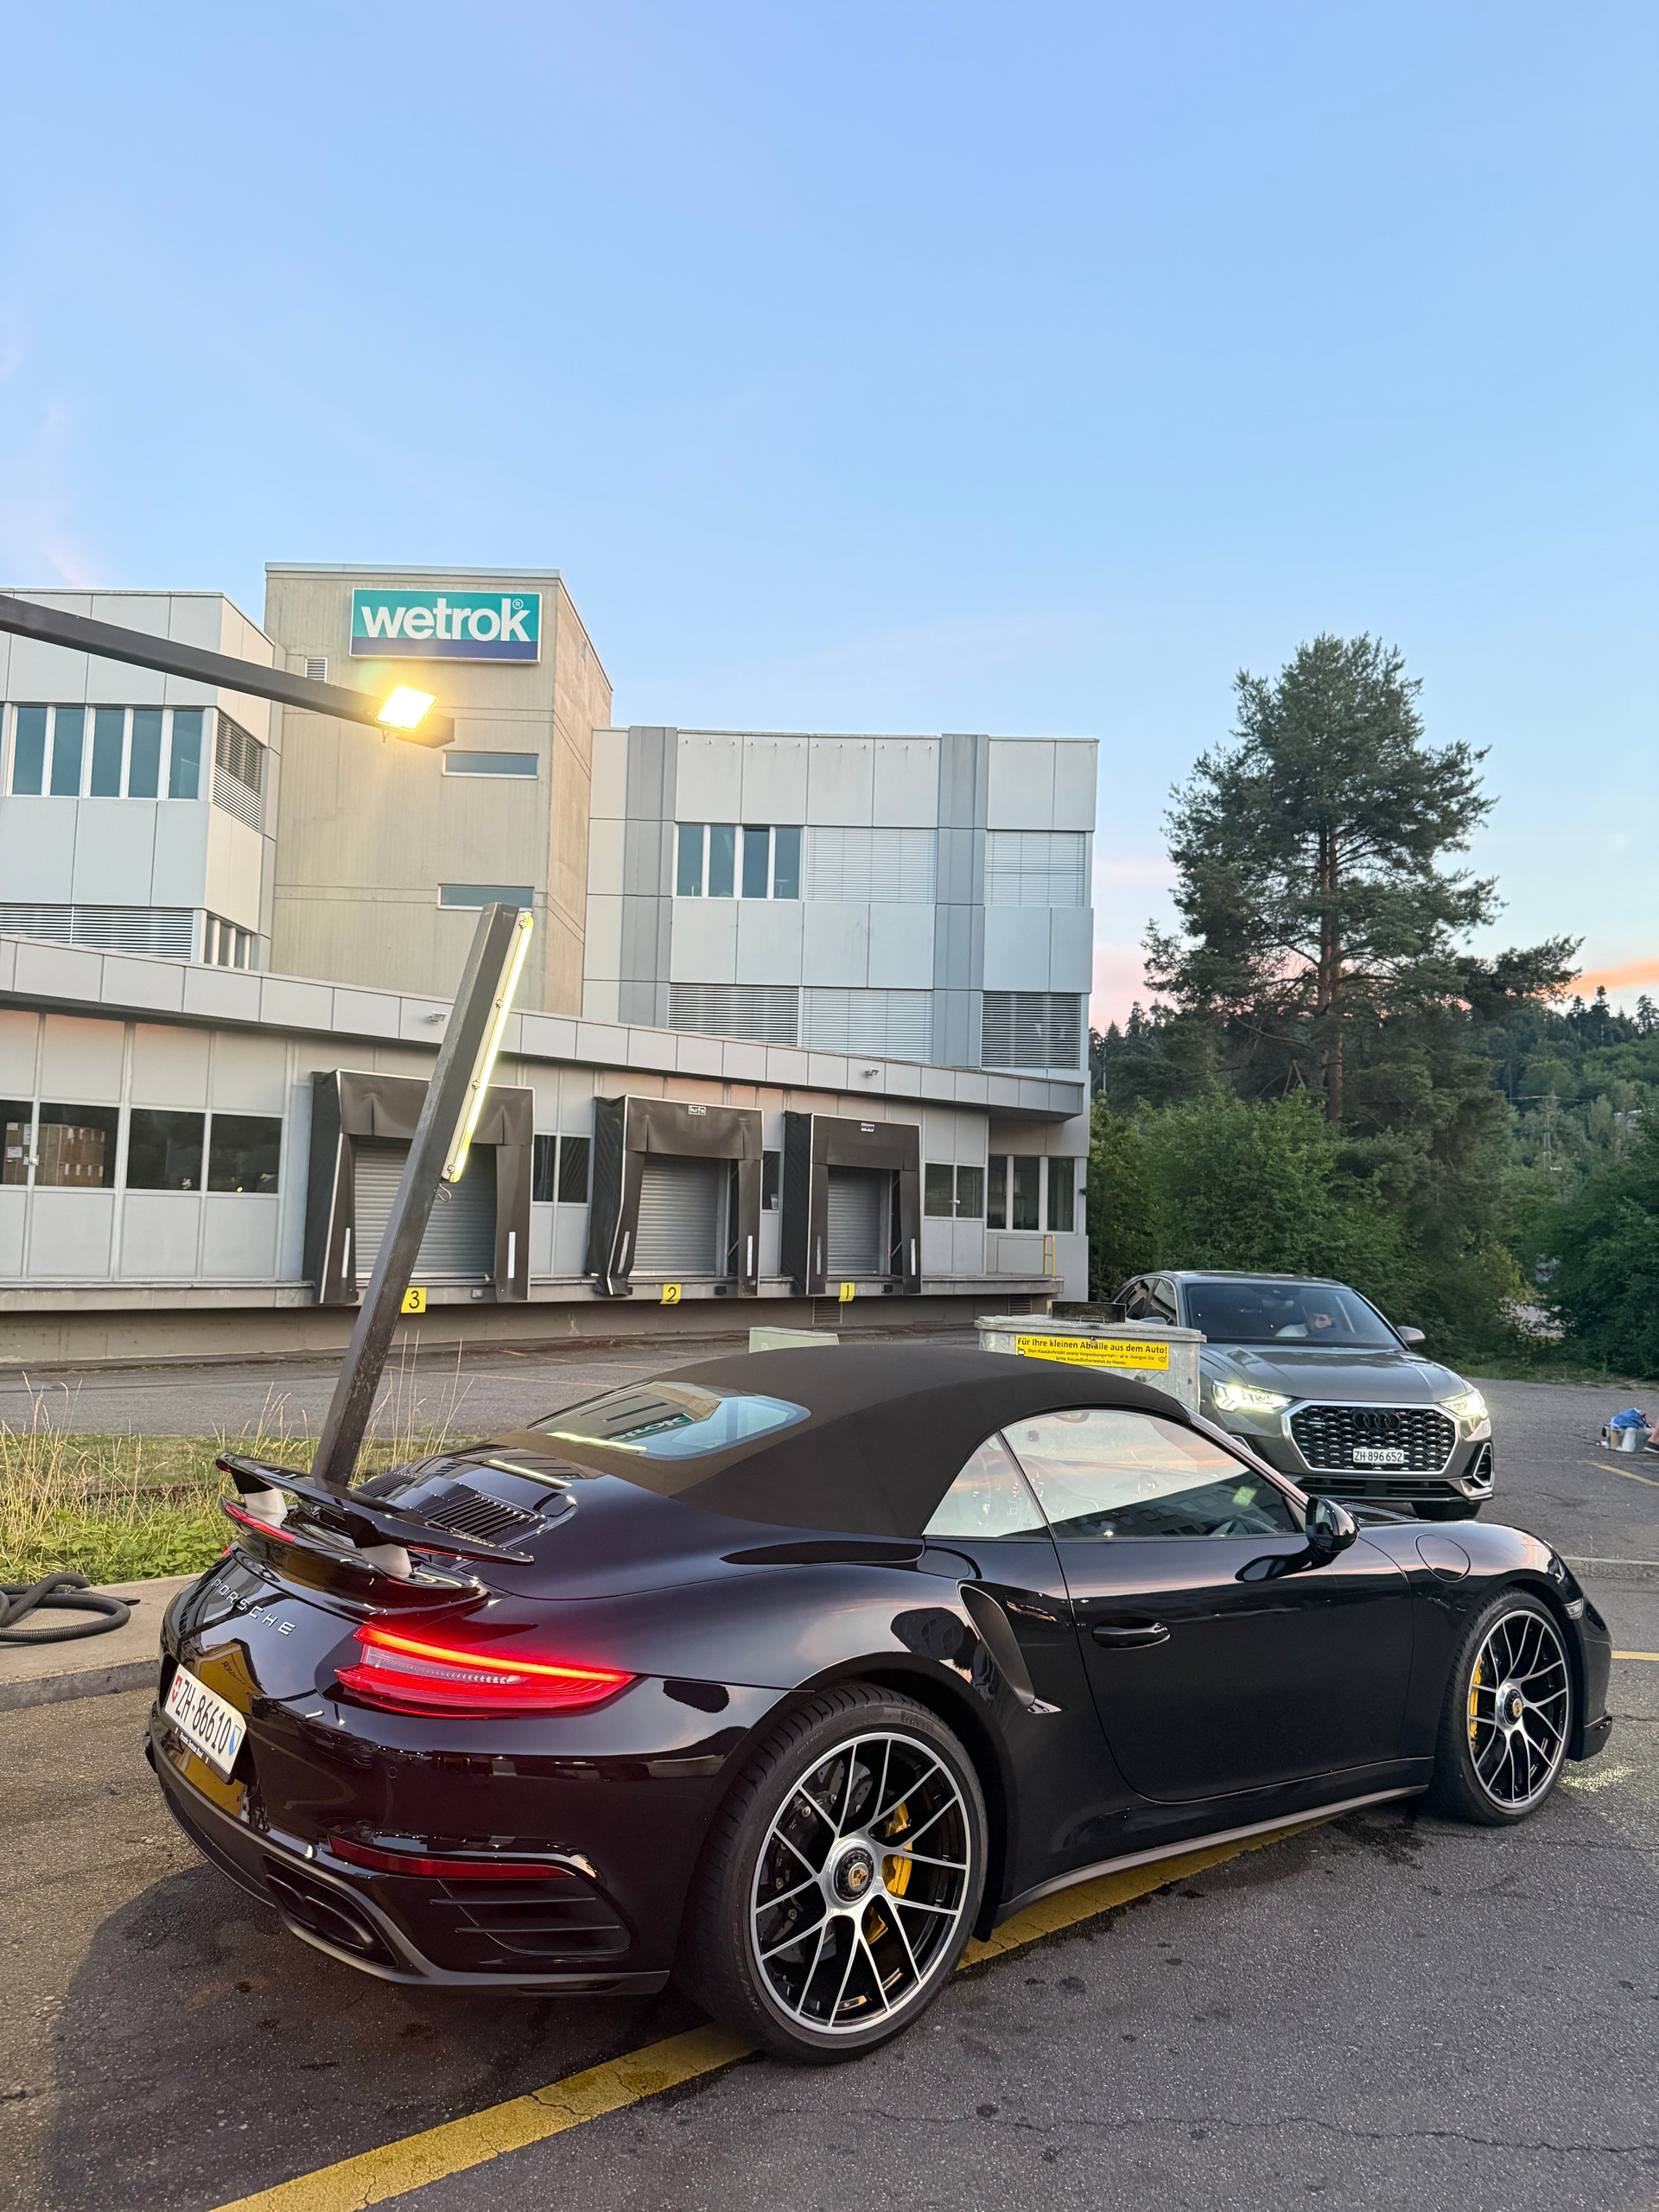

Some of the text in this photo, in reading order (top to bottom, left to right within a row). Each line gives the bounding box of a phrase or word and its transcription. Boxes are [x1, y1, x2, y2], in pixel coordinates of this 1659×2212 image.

[409, 1290, 420, 1309] 3
[666, 1287, 677, 1302] 2
[845, 1284, 850, 1300] 1
[1033, 1338, 1047, 1347] Ihre
[1049, 1339, 1078, 1349] kleinen
[1145, 1345, 1167, 1354] Auto!
[211, 1578, 296, 1636] PORSCHE
